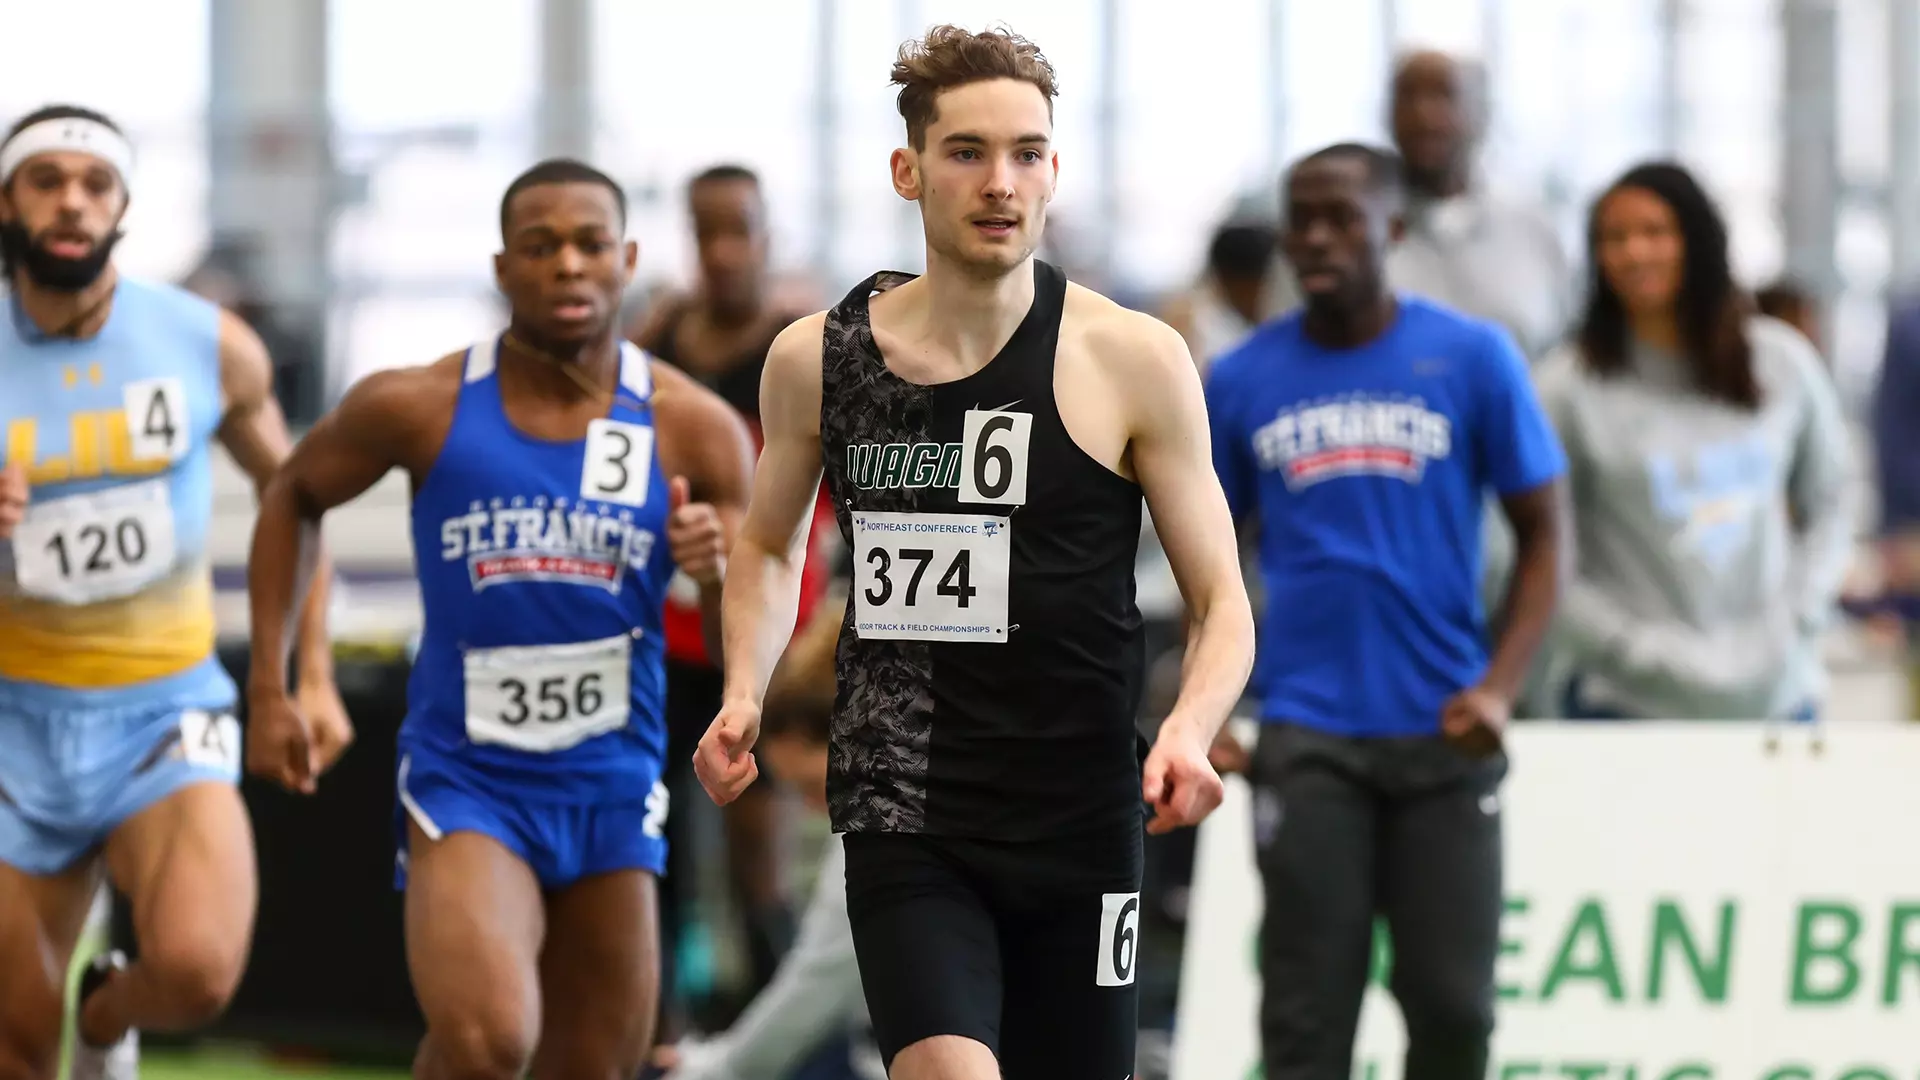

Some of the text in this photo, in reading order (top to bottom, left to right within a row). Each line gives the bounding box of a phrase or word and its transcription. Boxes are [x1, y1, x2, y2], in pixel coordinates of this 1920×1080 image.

[143, 388, 176, 447] 4
[596, 430, 632, 493] 3
[847, 443, 963, 490] WAGN
[973, 415, 1015, 499] 6
[45, 516, 148, 578] 120
[867, 522, 912, 532] NORTHEAST
[914, 524, 978, 534] CONFERENCE
[864, 546, 977, 609] 374
[874, 623, 898, 631] TRACK
[907, 624, 928, 632] FIELD
[929, 625, 990, 633] CHAMPIONSHIPS
[498, 672, 604, 726] 356
[1112, 897, 1138, 981] 6
